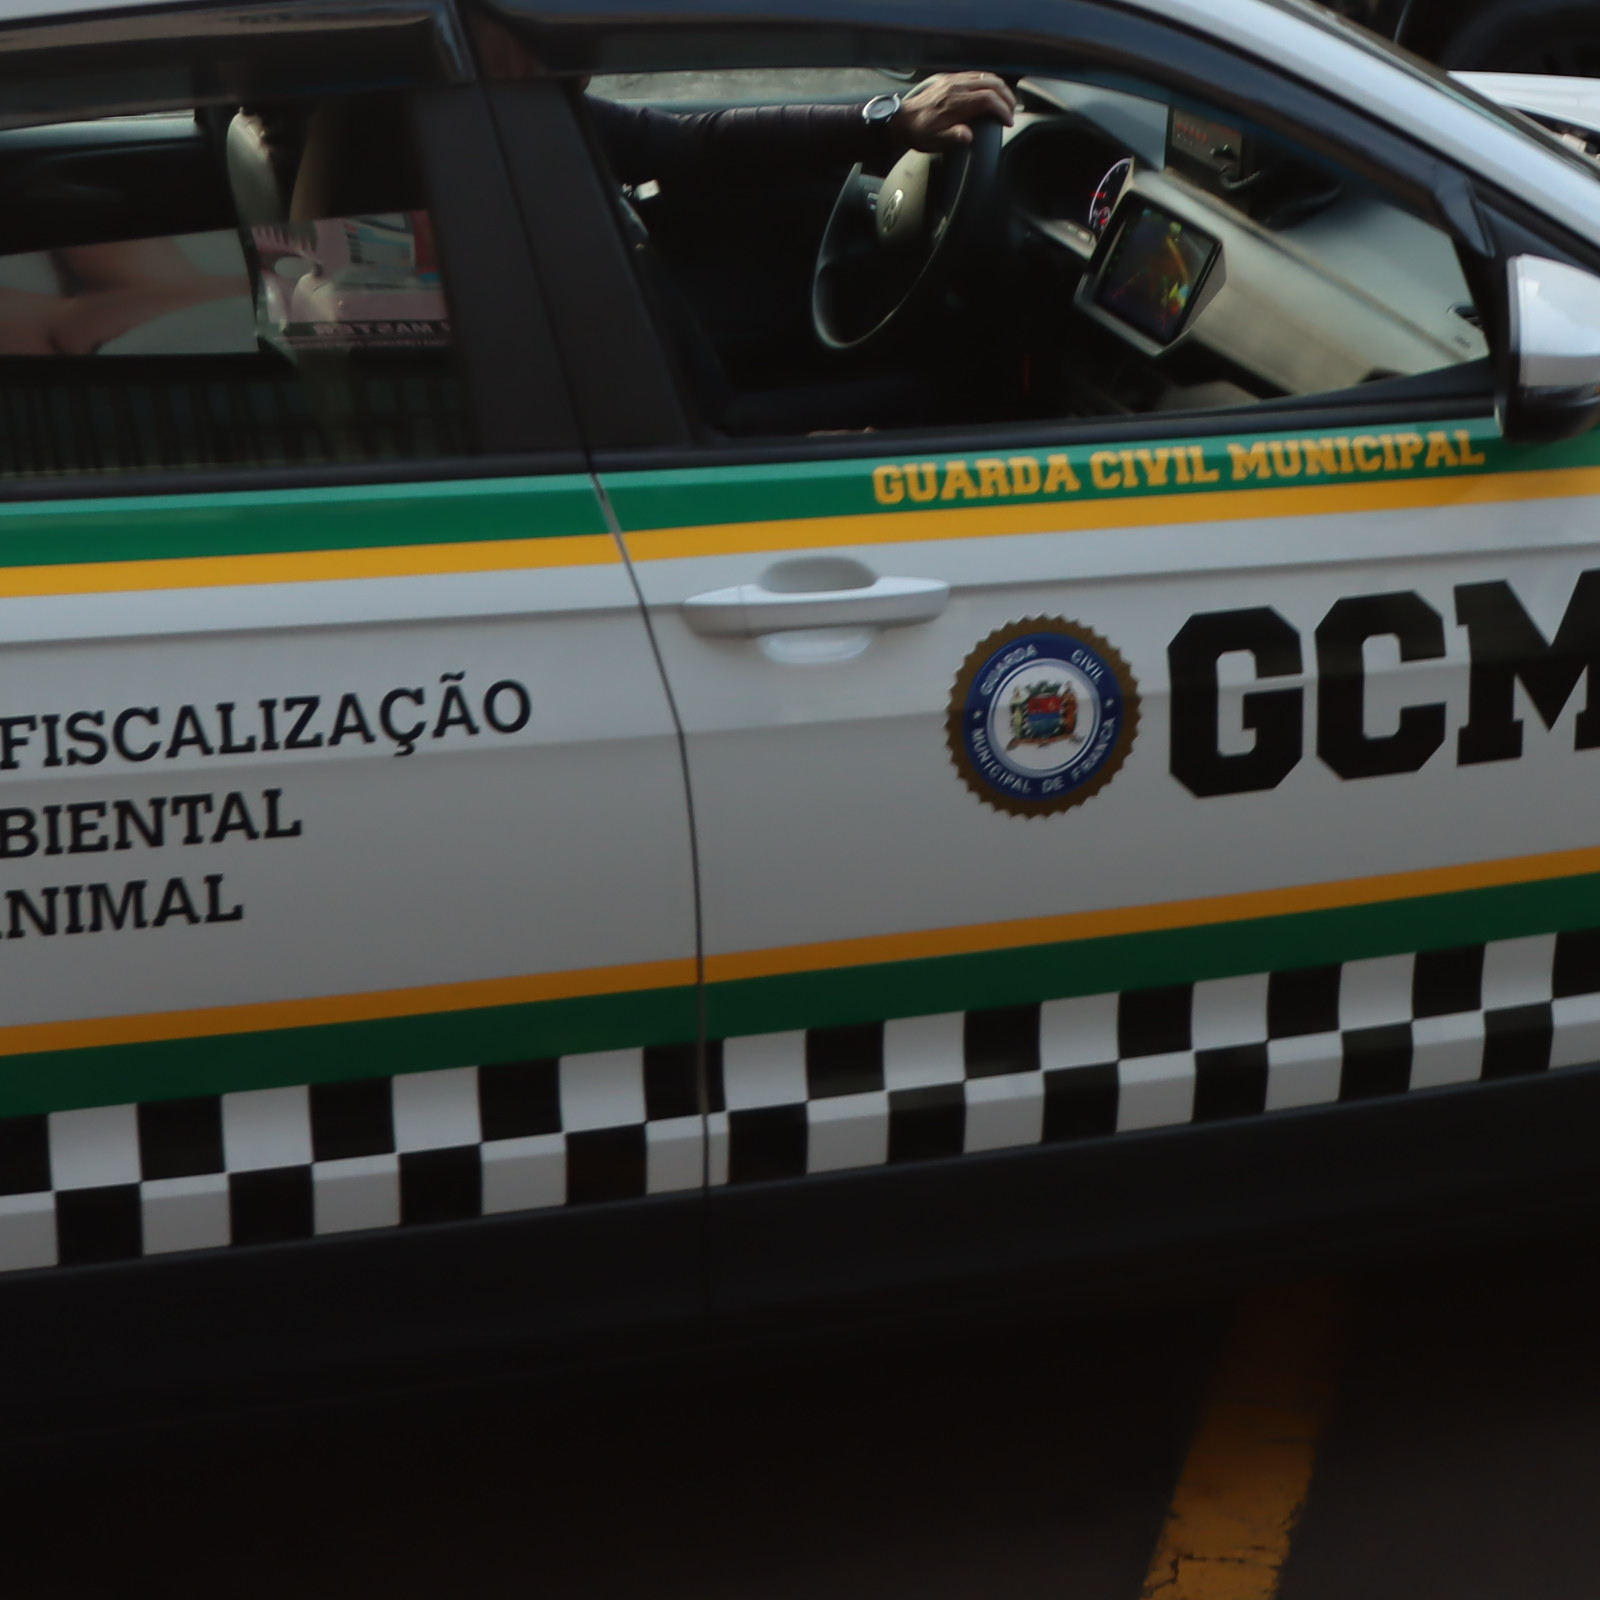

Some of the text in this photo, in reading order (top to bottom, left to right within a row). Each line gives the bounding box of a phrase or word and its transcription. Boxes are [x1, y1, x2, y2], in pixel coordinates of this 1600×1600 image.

[872, 430, 1486, 504] GUARDA CIVIL MUNICIPAL
